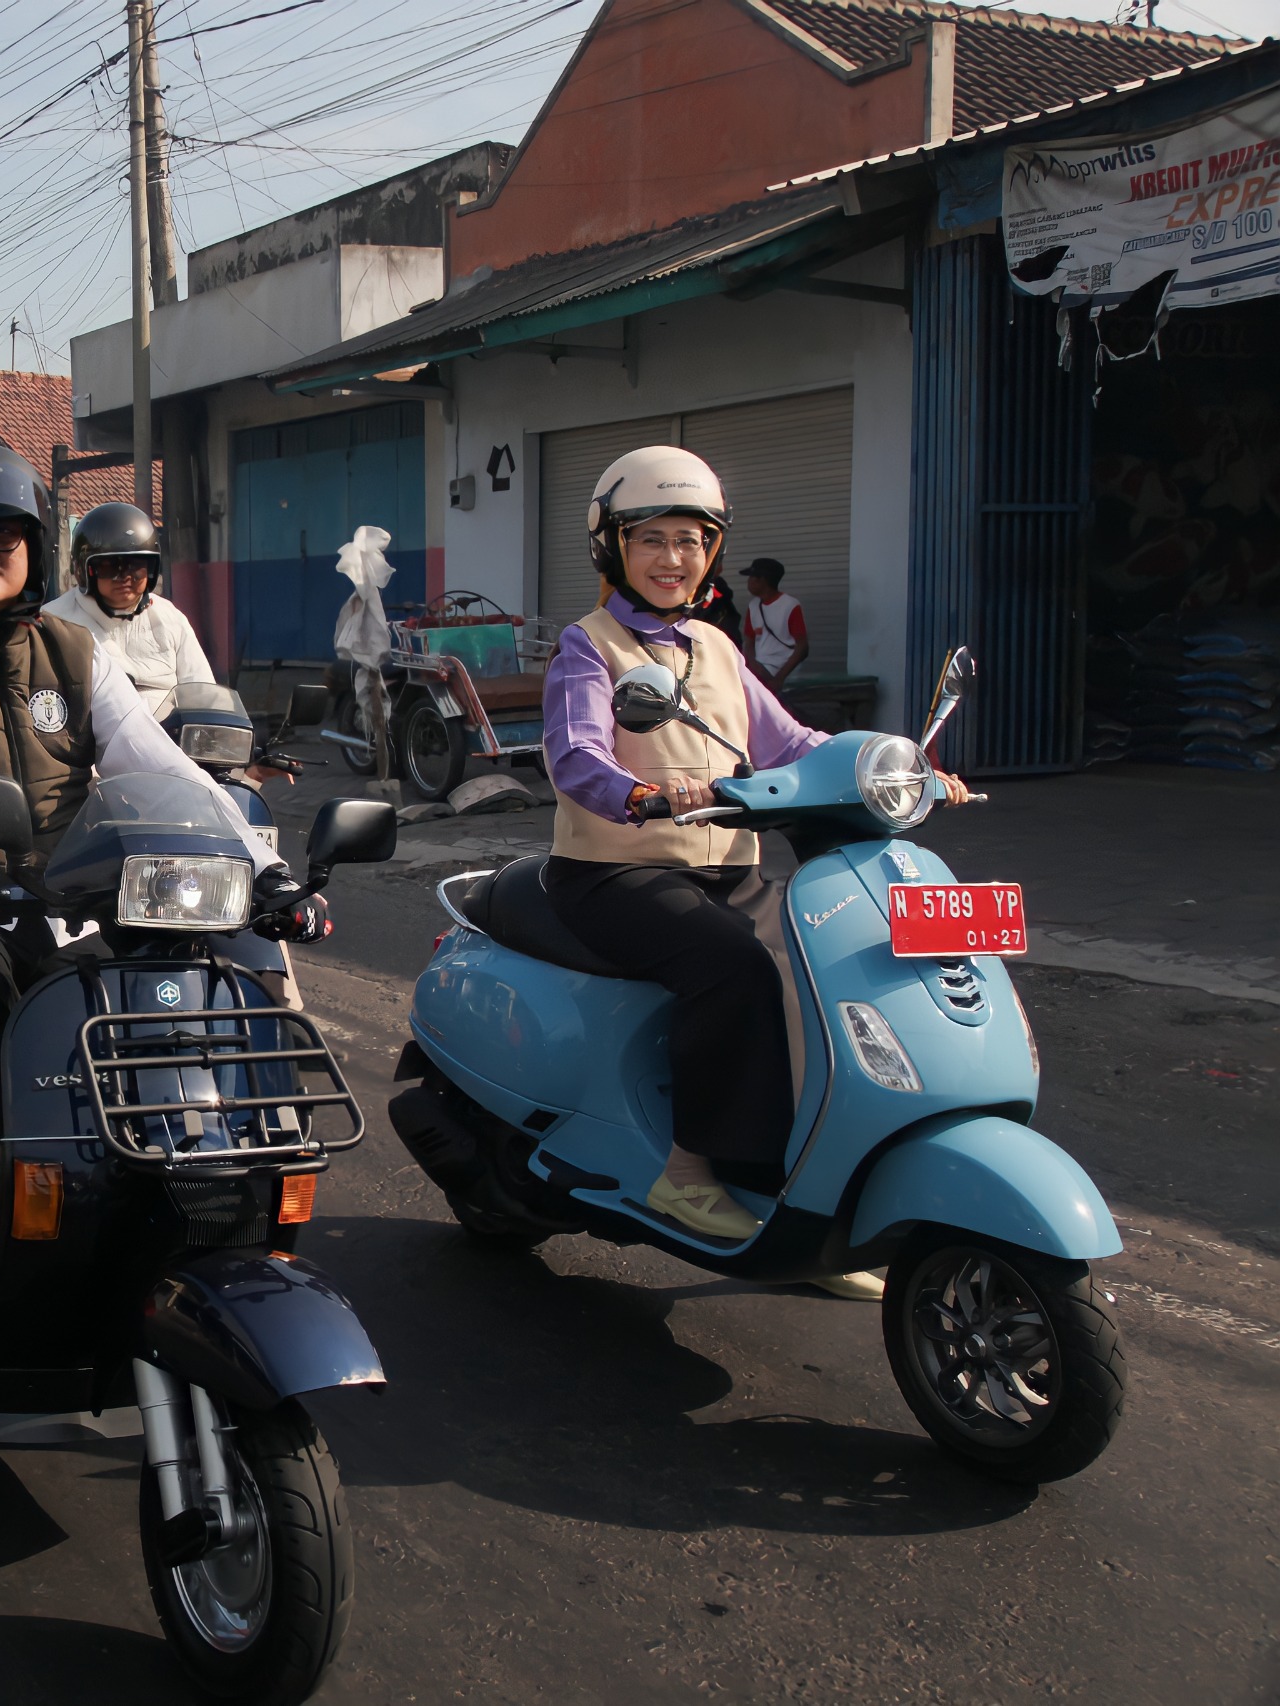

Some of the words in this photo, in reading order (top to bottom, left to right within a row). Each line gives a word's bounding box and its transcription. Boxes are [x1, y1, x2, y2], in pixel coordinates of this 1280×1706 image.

[1129, 159, 1203, 202] KREDIT
[1192, 221, 1228, 250] S/D
[1232, 208, 1273, 239] 100
[893, 889, 908, 919] N
[922, 889, 974, 919] 5789
[992, 889, 1019, 919] YP
